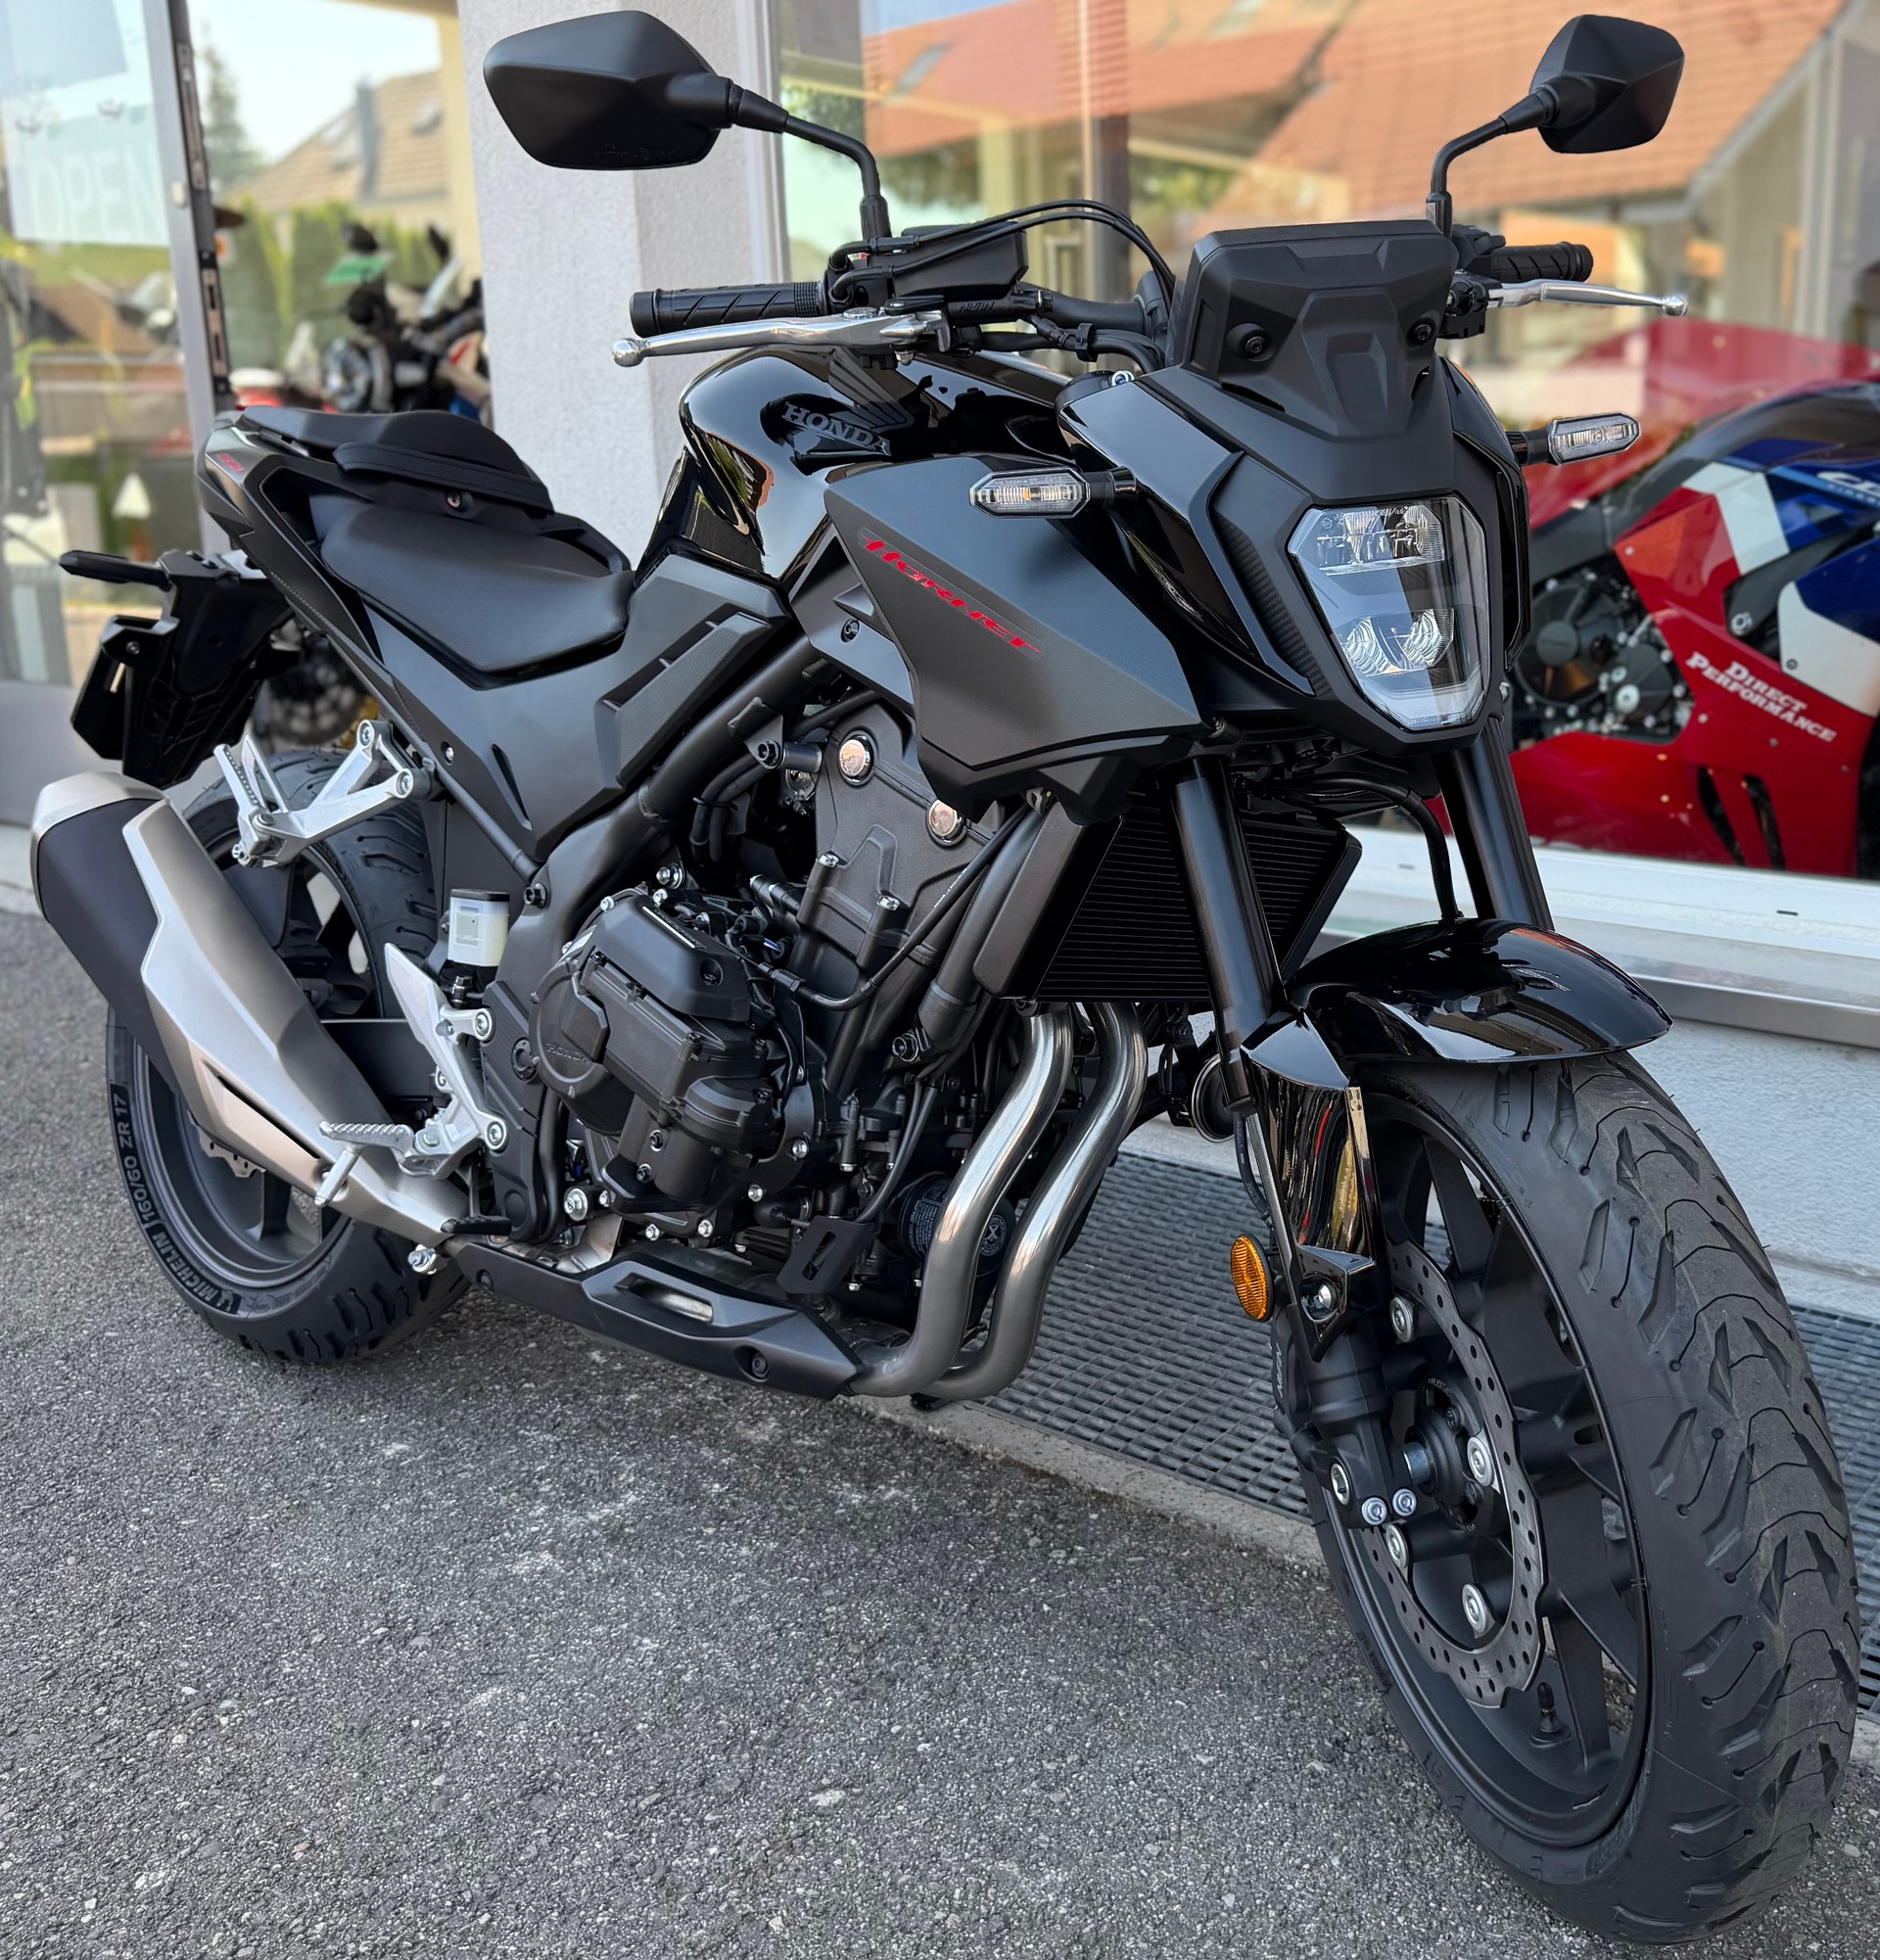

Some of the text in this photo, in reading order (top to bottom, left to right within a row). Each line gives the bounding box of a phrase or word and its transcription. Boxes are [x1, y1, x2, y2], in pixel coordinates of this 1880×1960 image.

[32, 143, 164, 243] OPEN
[781, 401, 892, 456] HONDA
[861, 534, 1042, 654] HORNET
[545, 1042, 591, 1064] HONDA
[113, 1093, 221, 1305] MICHELIN 160/60 ZR 17
